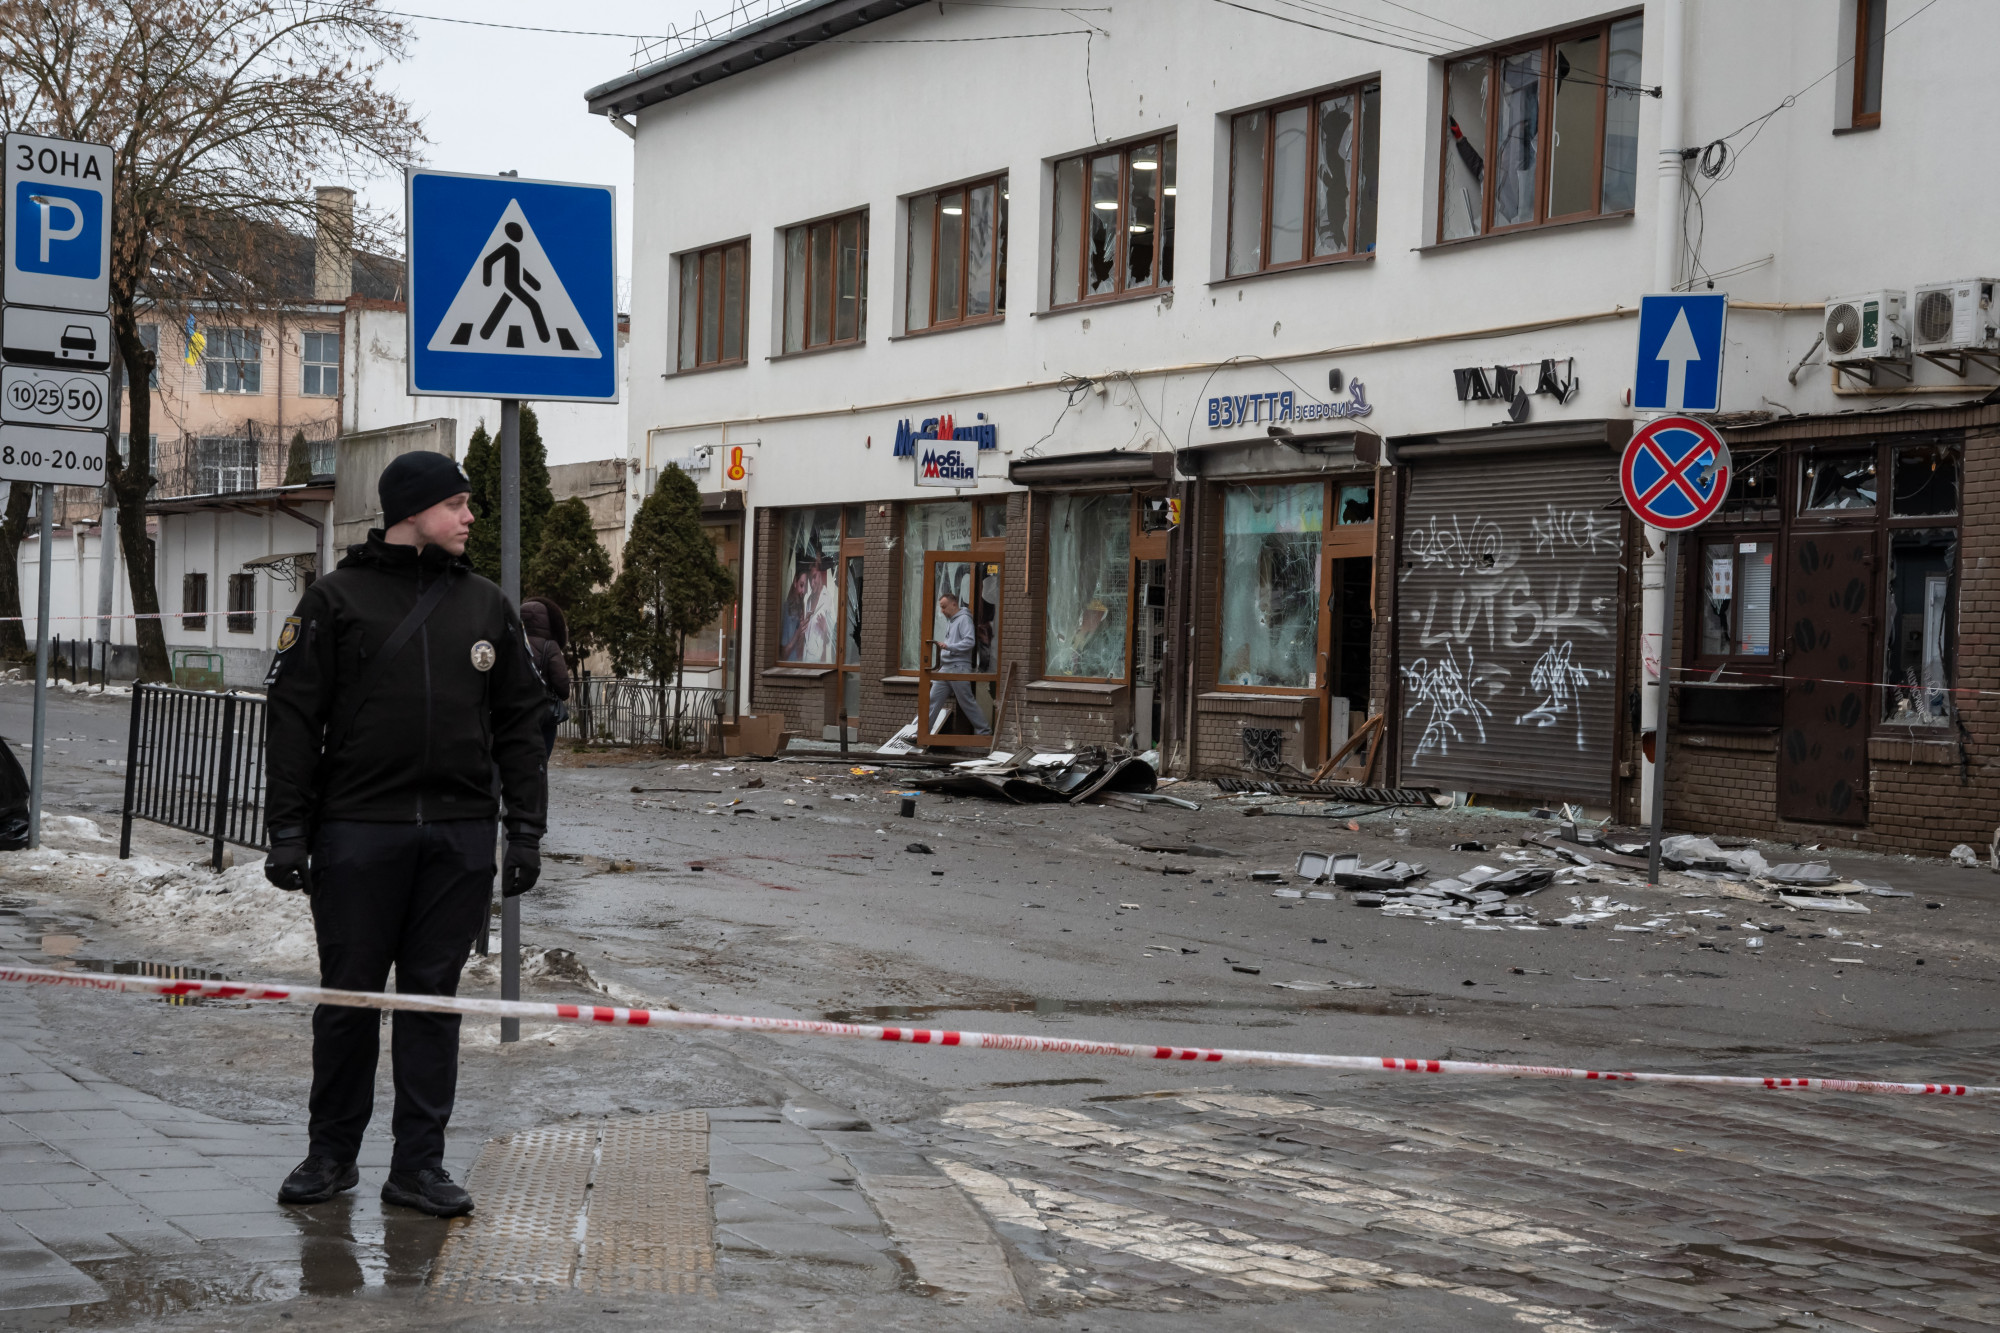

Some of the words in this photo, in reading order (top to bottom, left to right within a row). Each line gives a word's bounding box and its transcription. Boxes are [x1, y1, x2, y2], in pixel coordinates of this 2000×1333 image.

[16, 144, 102, 181] ЗОНА
[38, 195, 84, 263] P
[13, 386, 31, 403] 10
[37, 388, 60, 407] 25
[67, 389, 96, 411] 50
[1208, 390, 1294, 428] ВЗУТТЯ
[922, 448, 961, 466] Мобі
[924, 461, 974, 479] Манія
